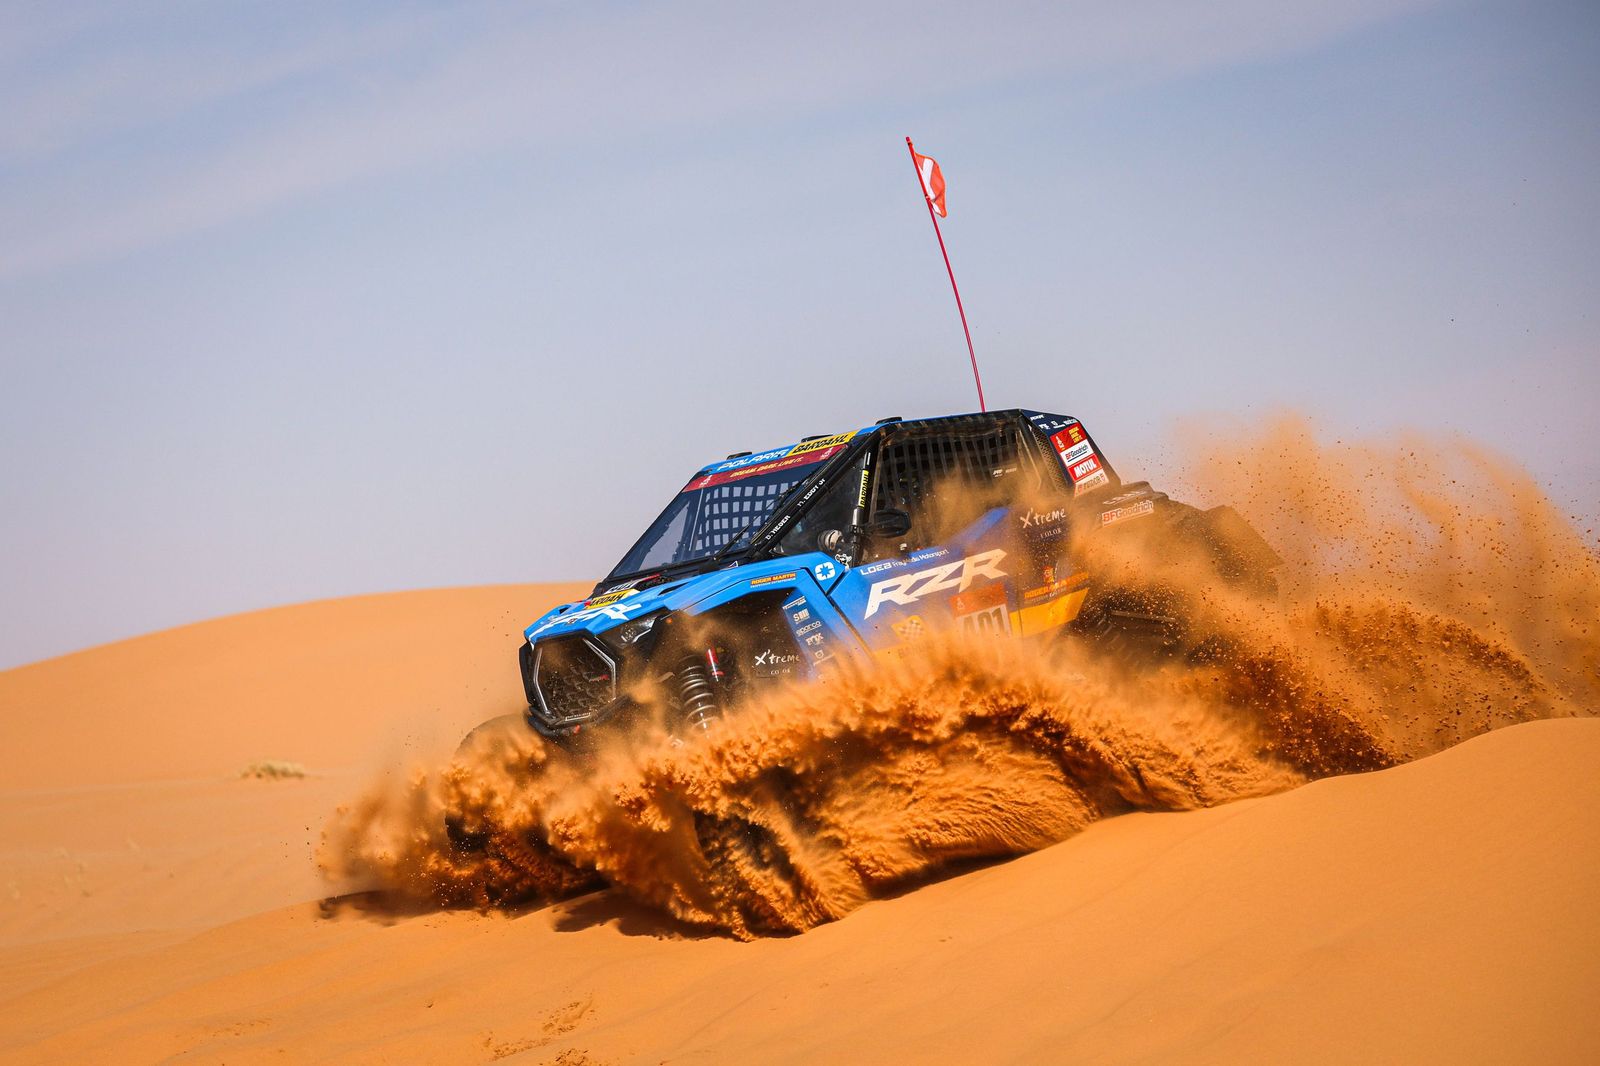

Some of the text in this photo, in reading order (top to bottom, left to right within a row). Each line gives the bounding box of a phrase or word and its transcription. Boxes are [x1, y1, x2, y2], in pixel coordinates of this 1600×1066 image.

[1065, 444, 1089, 461] BFGoodrich
[1073, 458, 1097, 478] MOTUL
[1103, 499, 1153, 522] BFGoodrich
[864, 548, 1008, 620] RZR
